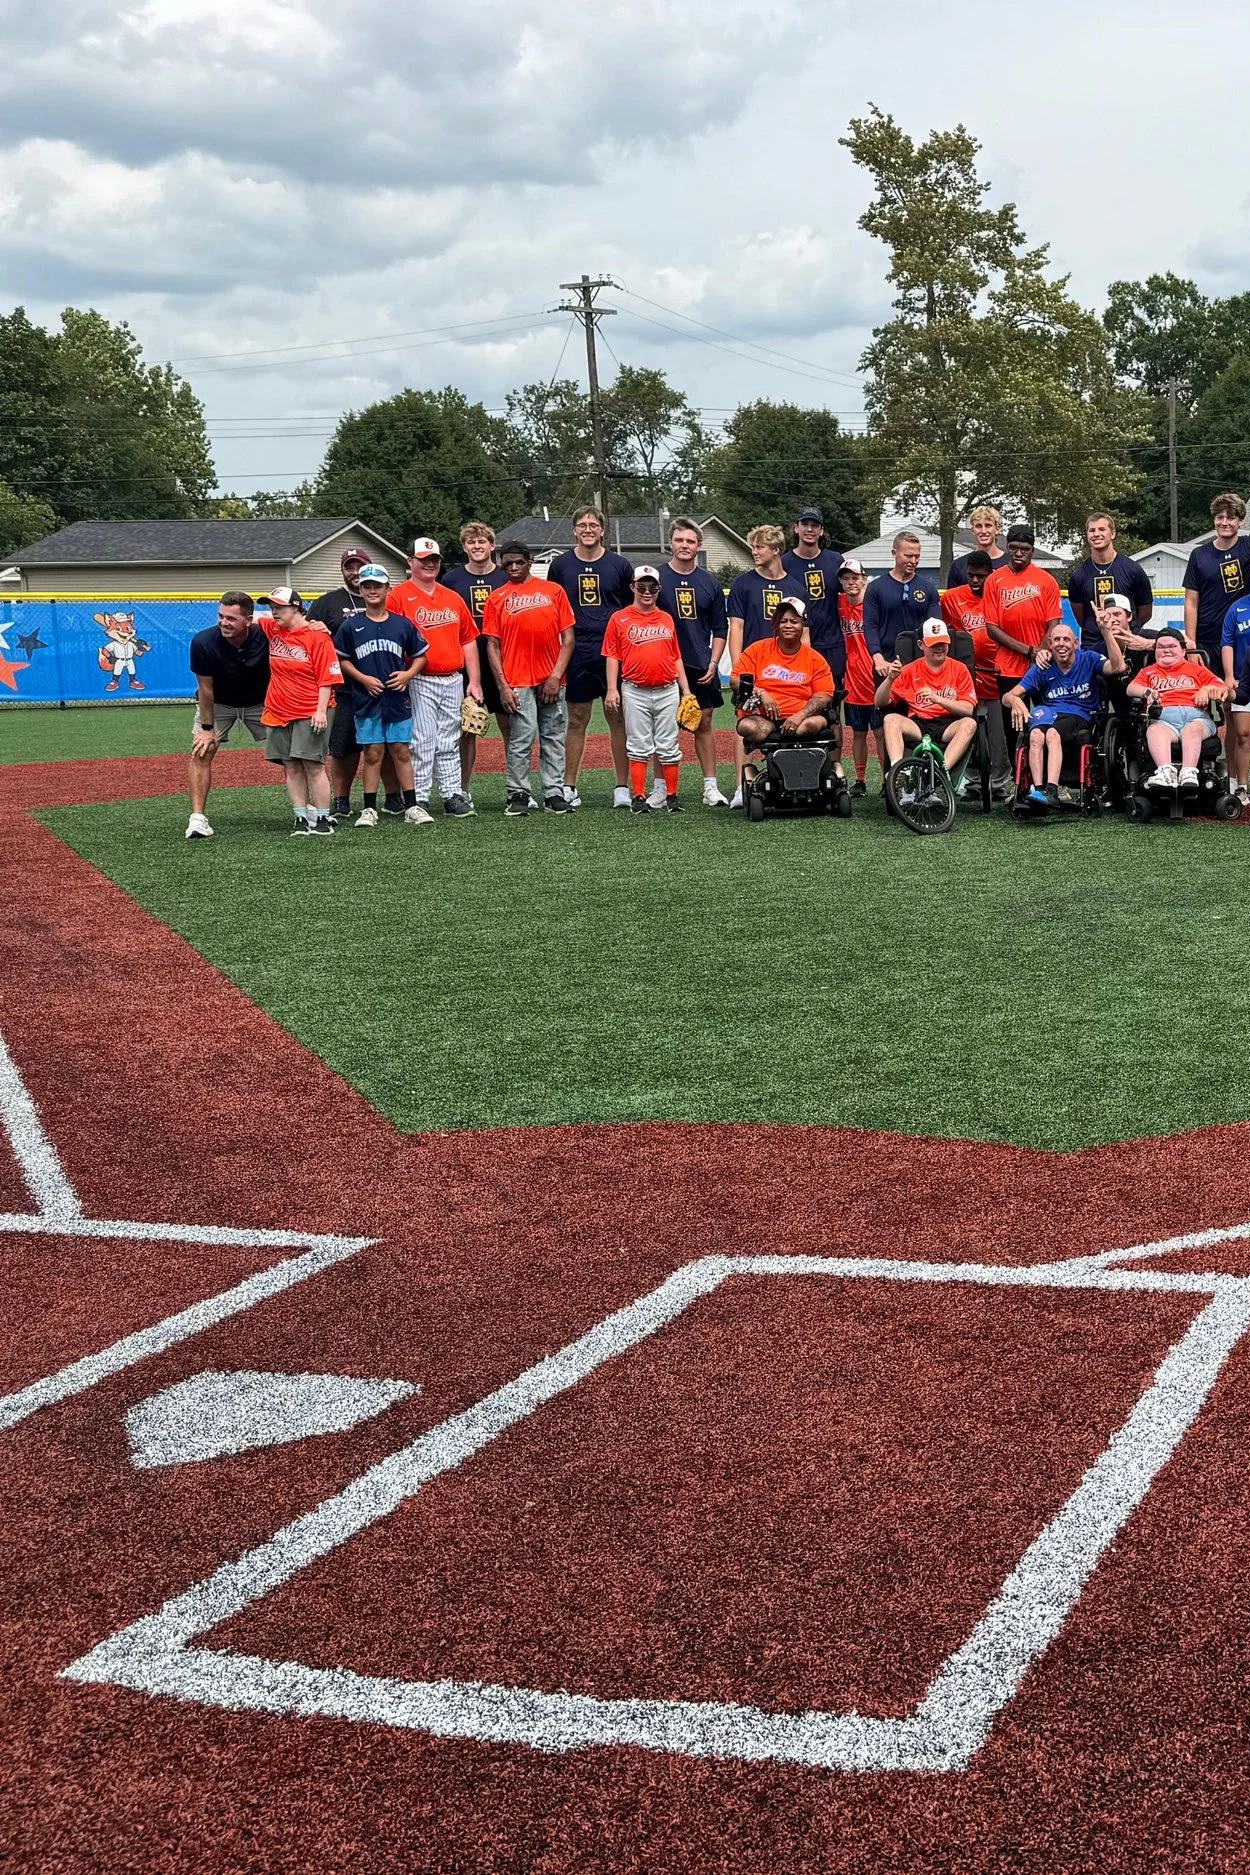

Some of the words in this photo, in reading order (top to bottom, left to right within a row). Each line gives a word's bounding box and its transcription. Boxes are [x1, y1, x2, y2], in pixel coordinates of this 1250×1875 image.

[504, 592, 551, 615] Orioles
[1001, 583, 1040, 608] Orioles
[415, 607, 459, 629] Orioles
[627, 624, 672, 645] Orioles
[271, 635, 310, 662] Orioles
[1048, 686, 1069, 699] BLUE
[1149, 674, 1196, 692] Orioles
